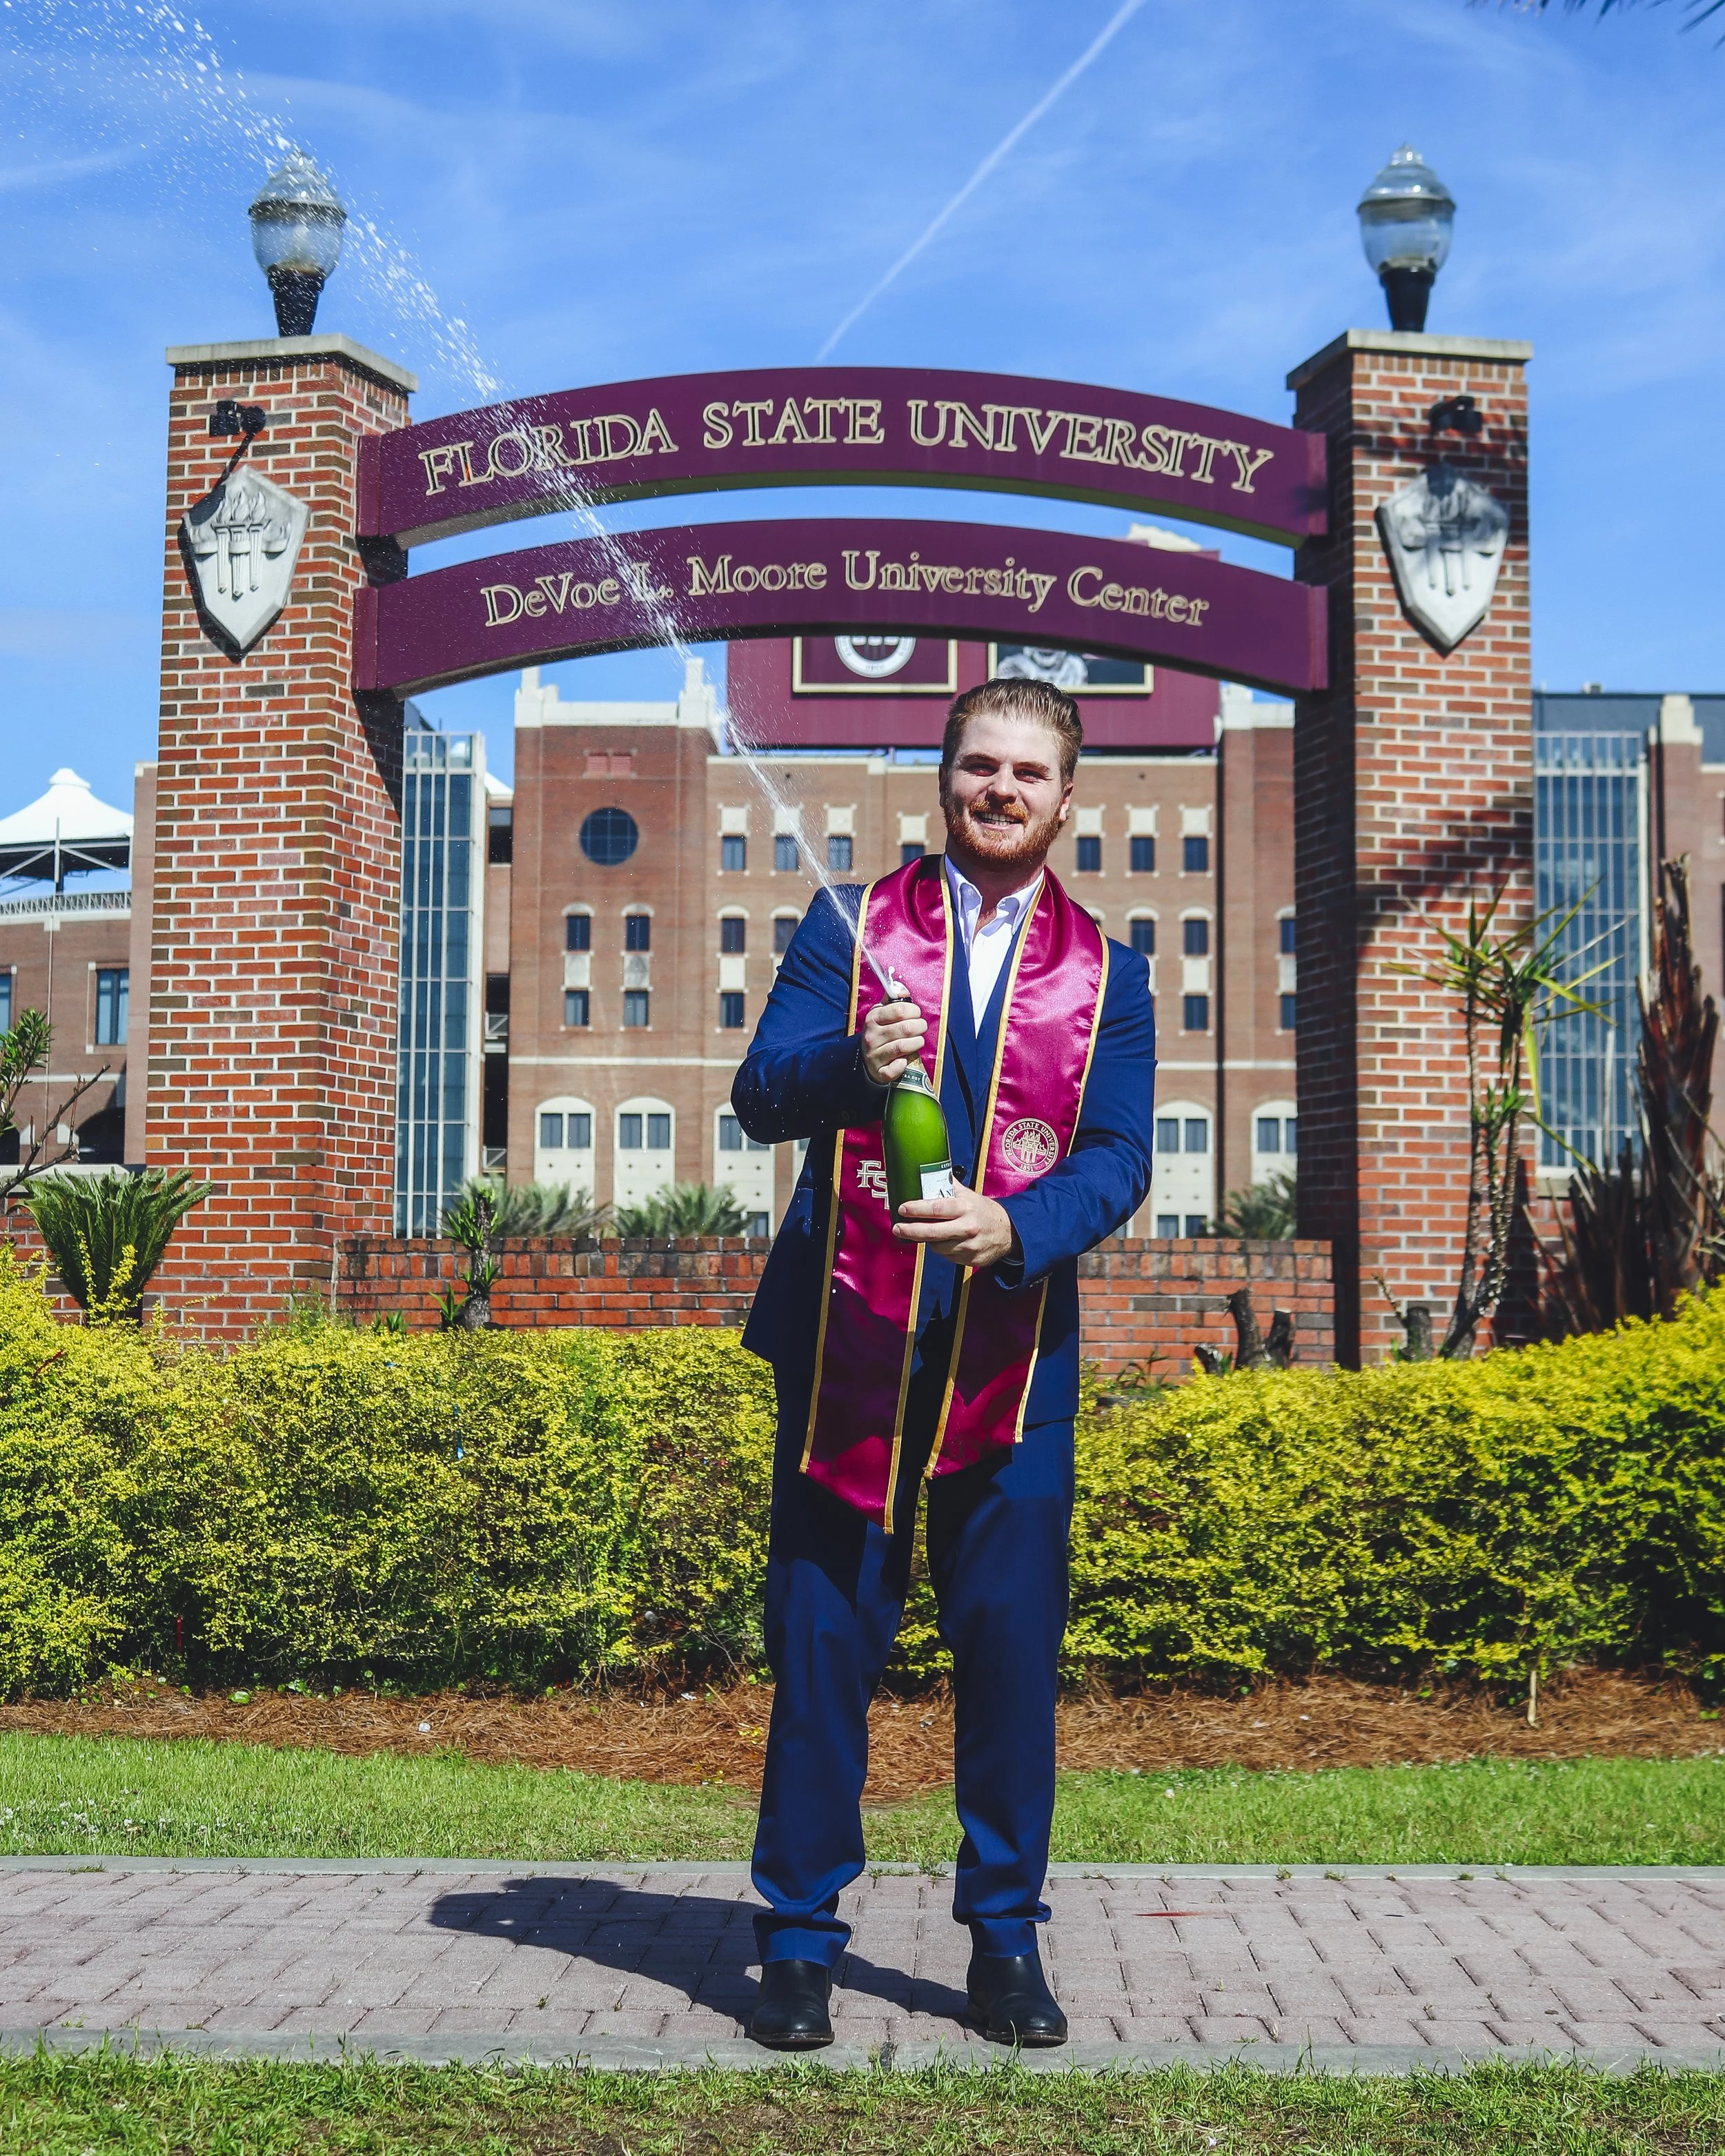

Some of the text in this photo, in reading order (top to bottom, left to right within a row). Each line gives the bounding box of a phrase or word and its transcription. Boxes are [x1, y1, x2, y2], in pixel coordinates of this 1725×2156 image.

[418, 397, 1274, 495] FLORIDA STATE UNIVERSITY
[481, 571, 620, 626] DeVoe
[687, 554, 827, 597] Moore
[842, 551, 1056, 613] University
[1067, 566, 1210, 626] Center
[1005, 1127, 1019, 1156] FLORIDA
[1041, 1126, 1055, 1166] UNIVERSITY
